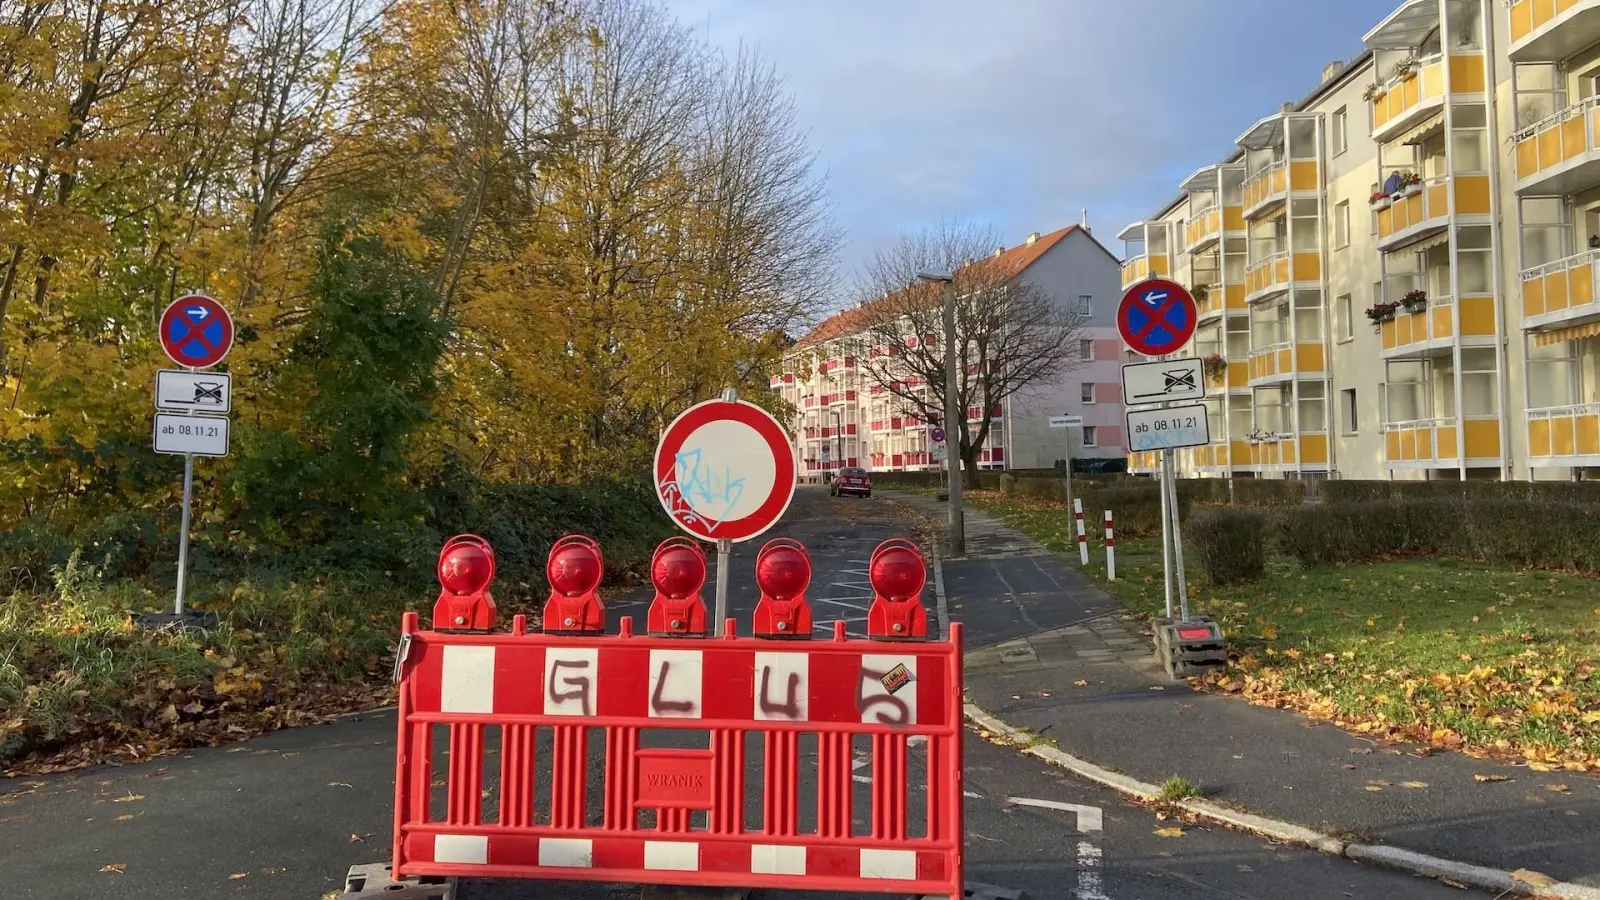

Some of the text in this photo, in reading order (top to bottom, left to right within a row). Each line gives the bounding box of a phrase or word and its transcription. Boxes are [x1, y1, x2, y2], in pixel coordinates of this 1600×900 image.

[162, 425, 218, 437] ab 08.11.21
[1135, 417, 1197, 433] ab 08.11.21
[647, 773, 704, 788] WRANIK
